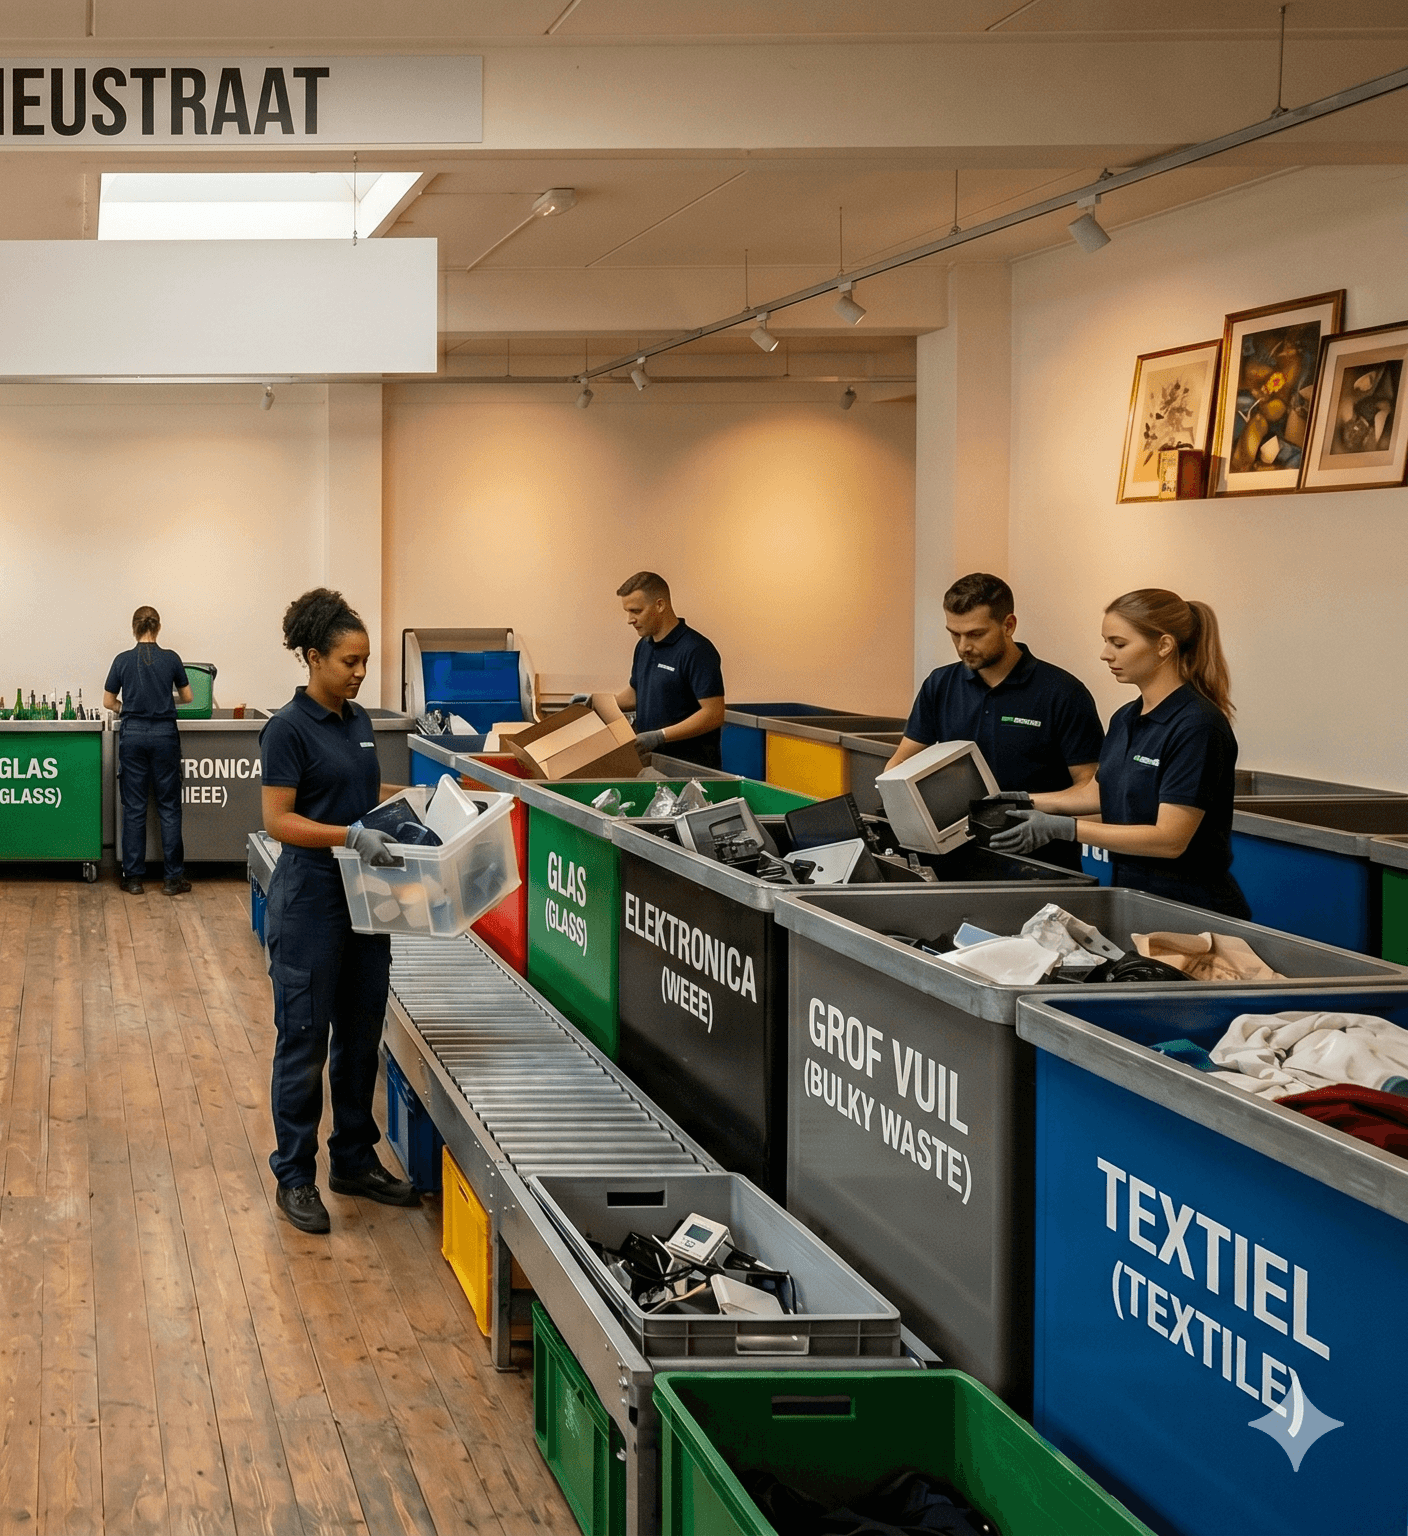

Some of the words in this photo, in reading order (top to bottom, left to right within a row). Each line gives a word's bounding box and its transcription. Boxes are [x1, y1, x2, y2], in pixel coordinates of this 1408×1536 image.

[546, 897, 588, 957] (GLASS)
[548, 851, 587, 907] GLAS
[625, 891, 757, 1003] ELEKTRONICA
[661, 965, 713, 1034] (WEEE)
[808, 997, 884, 1077] GROF
[891, 1038, 969, 1136] VUIL
[804, 1057, 875, 1132] (BULKY
[879, 1102, 972, 1205] WASTE)
[1096, 1156, 1330, 1361] TEXTIEL
[1112, 1260, 1305, 1439] (TEXTILE)
